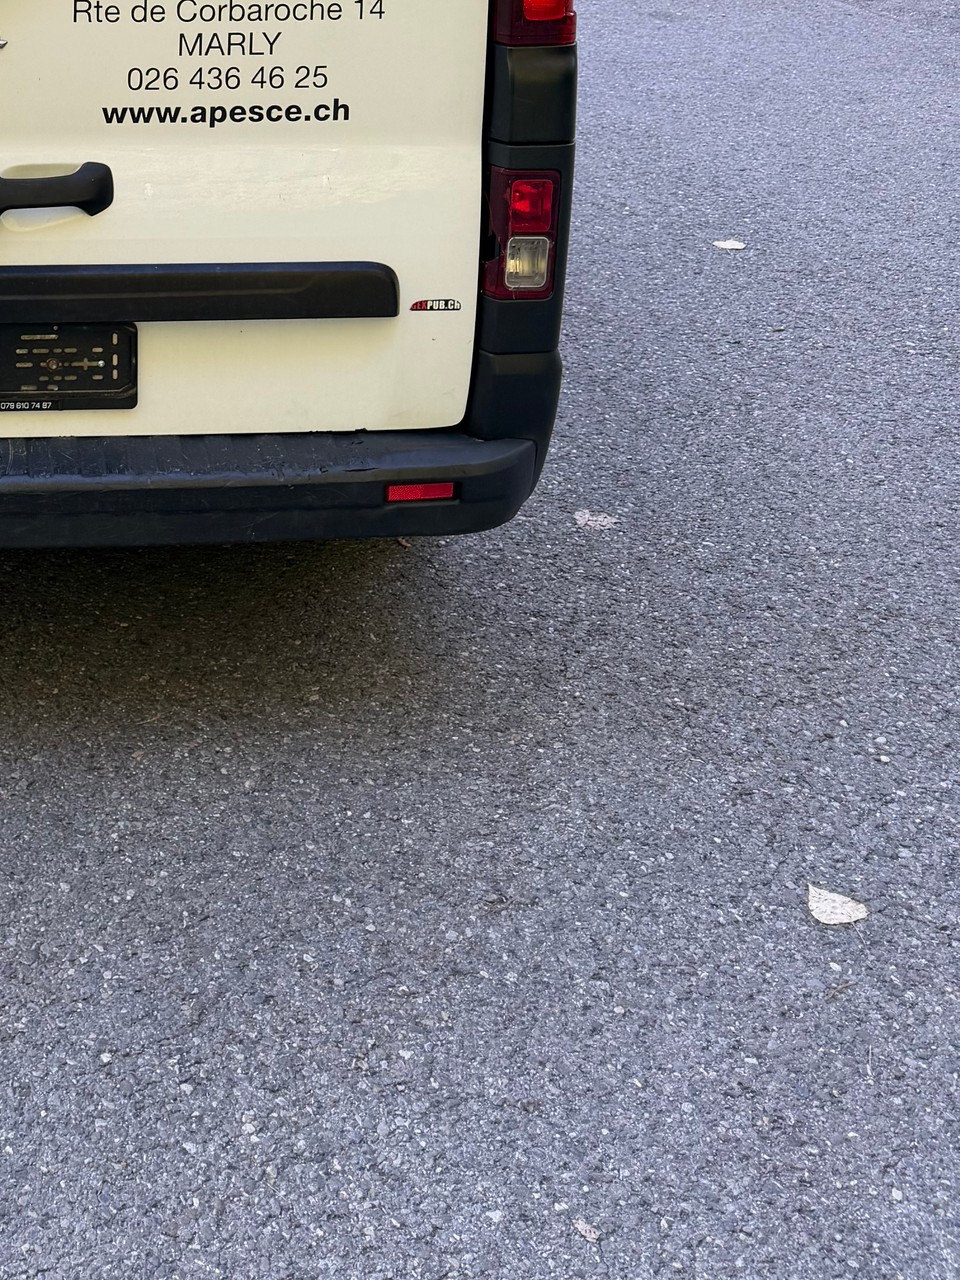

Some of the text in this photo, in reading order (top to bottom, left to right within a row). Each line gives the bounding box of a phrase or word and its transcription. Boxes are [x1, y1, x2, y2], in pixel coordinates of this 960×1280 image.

[131, 0, 166, 22] de
[178, 32, 282, 56] MARLY
[127, 65, 328, 91] 026 436 46 25
[102, 98, 350, 128] www.apesce.ch
[16, 401, 30, 409] 610
[31, 401, 41, 409] 74
